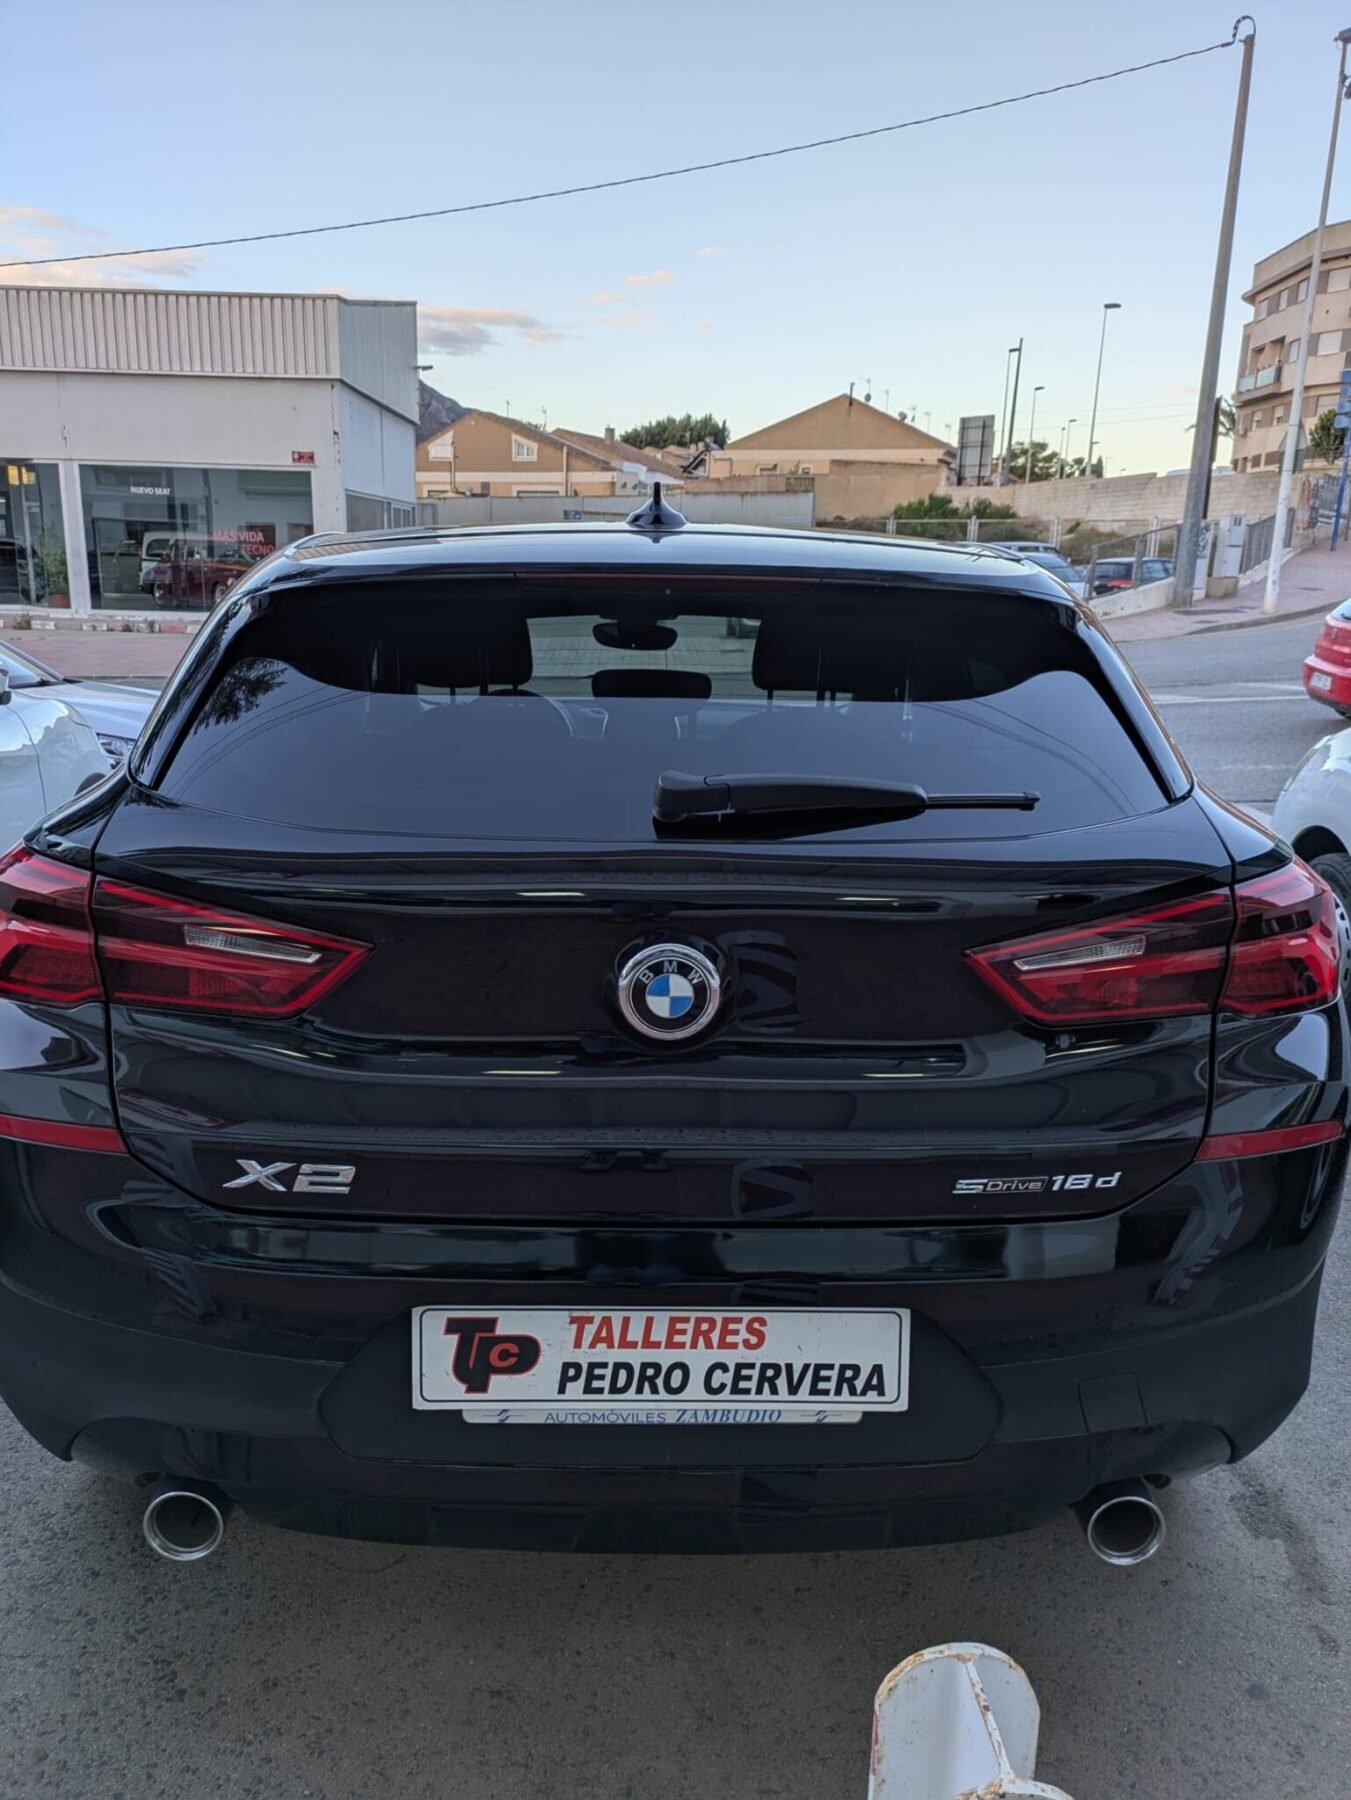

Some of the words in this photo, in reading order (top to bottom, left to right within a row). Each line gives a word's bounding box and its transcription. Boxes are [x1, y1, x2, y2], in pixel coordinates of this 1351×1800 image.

[238, 531, 265, 542] VIDA
[639, 960, 704, 985] BMW
[222, 1159, 356, 1195] X2
[569, 1316, 767, 1350] TALLERES
[557, 1361, 690, 1395] PEDRO
[703, 1362, 886, 1397] CERVERA
[544, 1410, 667, 1424] AUTOMÓVILES
[675, 1409, 783, 1424] ZAMBUDIO
